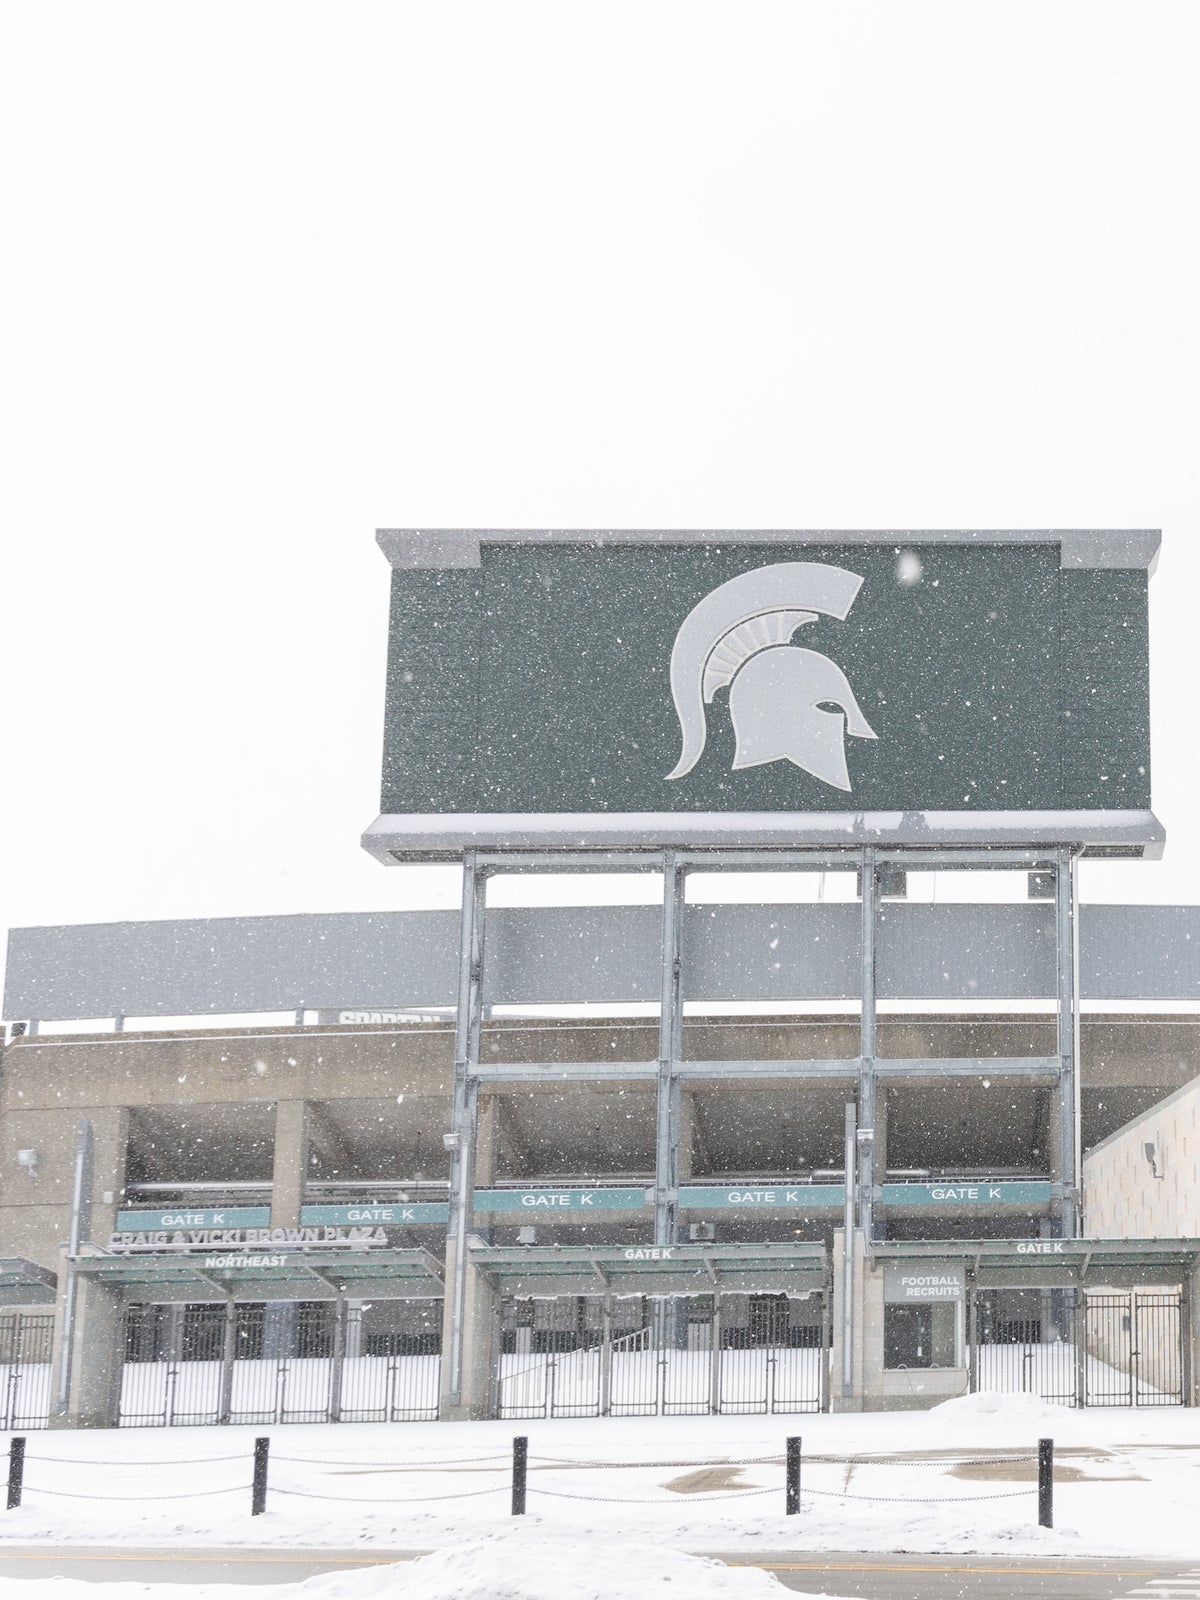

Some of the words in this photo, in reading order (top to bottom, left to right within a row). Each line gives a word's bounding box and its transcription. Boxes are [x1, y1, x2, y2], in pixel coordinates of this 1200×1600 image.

[728, 1191, 776, 1203] GATE
[786, 1191, 798, 1202] K
[931, 1188, 979, 1200] GATE
[989, 1187, 1002, 1199] K
[521, 1194, 570, 1206] GATE
[580, 1194, 593, 1205] K
[161, 1215, 204, 1226] GATE
[213, 1214, 225, 1224] K
[347, 1210, 393, 1221] GATE
[402, 1209, 414, 1220] K
[110, 1232, 167, 1245] CRAIG
[172, 1232, 187, 1244] &
[191, 1230, 240, 1244] VICKI
[246, 1229, 319, 1242] BROWN
[324, 1227, 387, 1240] PLAZA
[625, 1249, 660, 1260] GATE
[662, 1248, 672, 1259] K
[1017, 1243, 1050, 1254] GATE
[1054, 1243, 1064, 1253] K
[205, 1256, 288, 1268] NORTHEAST
[901, 1277, 960, 1286] FOOTBALL
[906, 1287, 960, 1296] RECRUITS
